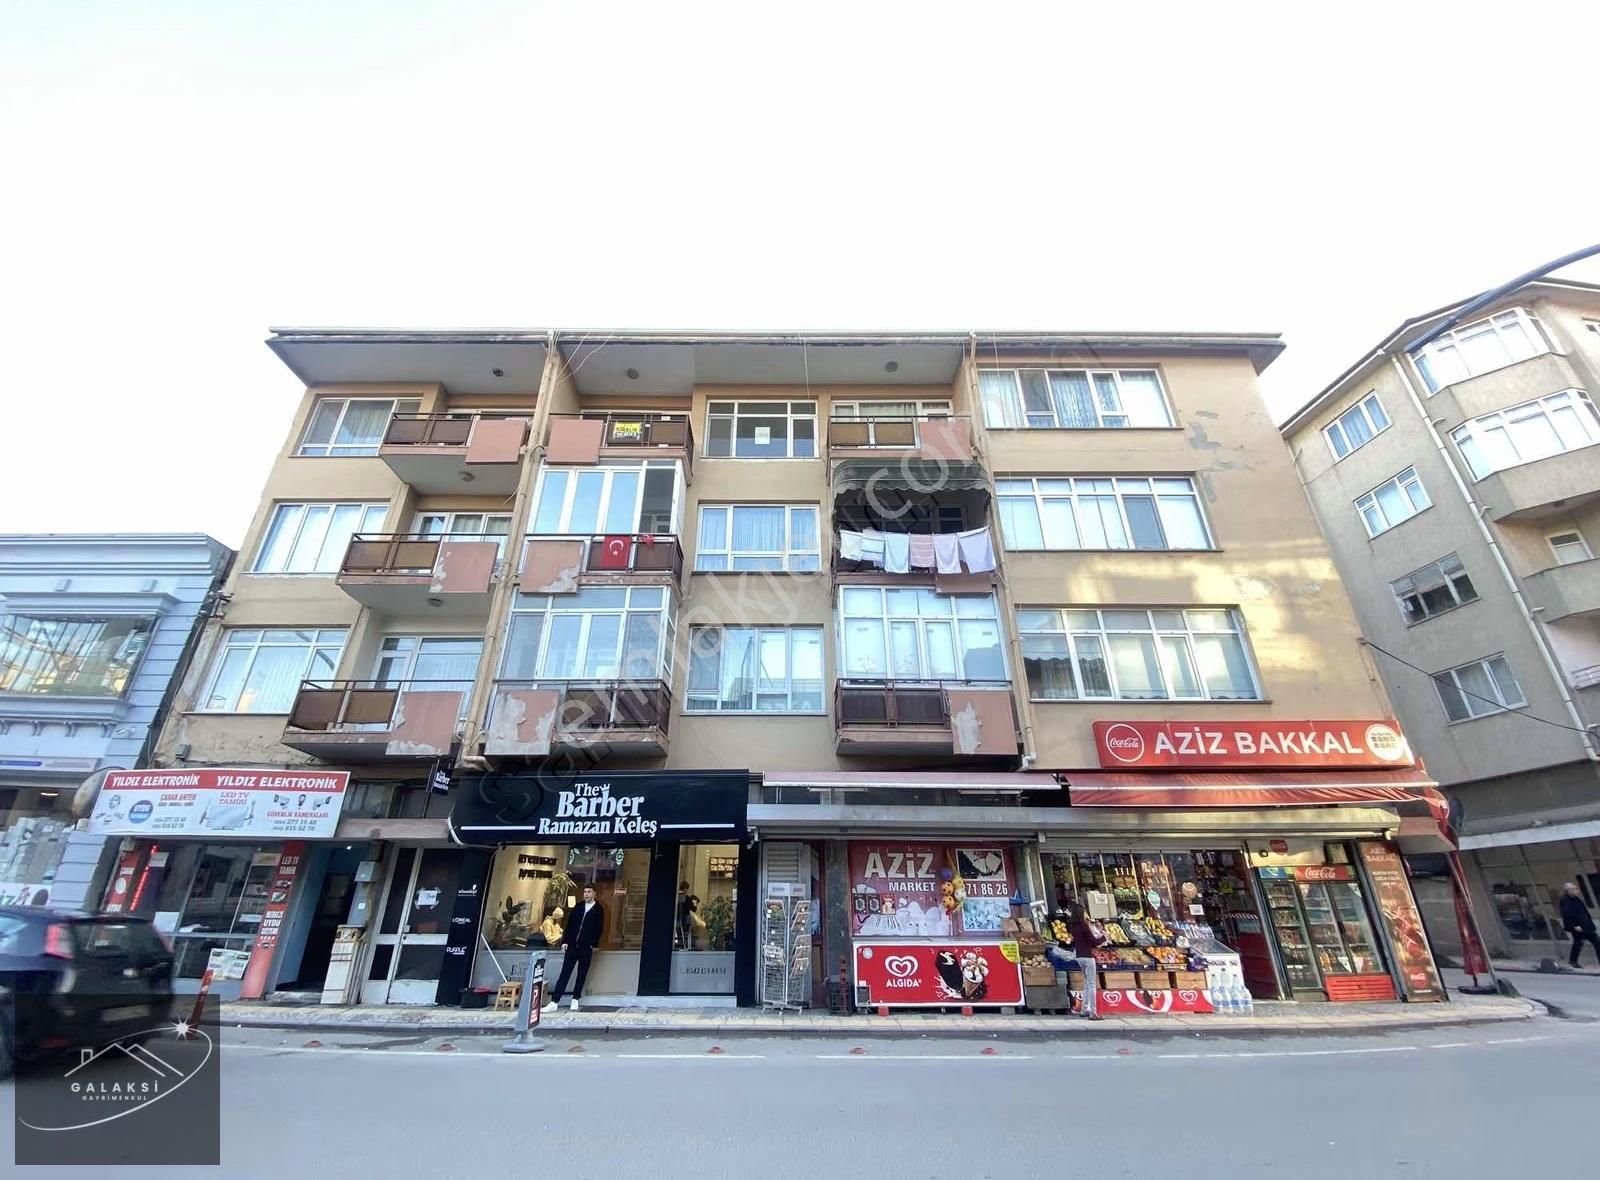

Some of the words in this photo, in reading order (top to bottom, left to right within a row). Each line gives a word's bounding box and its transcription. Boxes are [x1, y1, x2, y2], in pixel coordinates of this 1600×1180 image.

[1155, 726, 1228, 755] AZİZ
[1234, 731, 1364, 755] BAKKAL
[112, 775, 140, 787] YILDIZ
[141, 773, 201, 786] ELEKTRONİK
[216, 775, 258, 787] YILDIZ
[258, 776, 338, 789] ELEKTRONİK
[574, 782, 600, 797] The
[555, 790, 645, 817] Barber
[537, 817, 611, 835] Ramazan
[613, 816, 658, 838] Keleş
[1304, 866, 1336, 879] Coca-Cola
[888, 881, 936, 892] MARKET
[981, 883, 993, 895] 86
[996, 883, 1008, 895] 26
[263, 919, 281, 927] UYDU
[885, 979, 919, 988] ALGIDA
